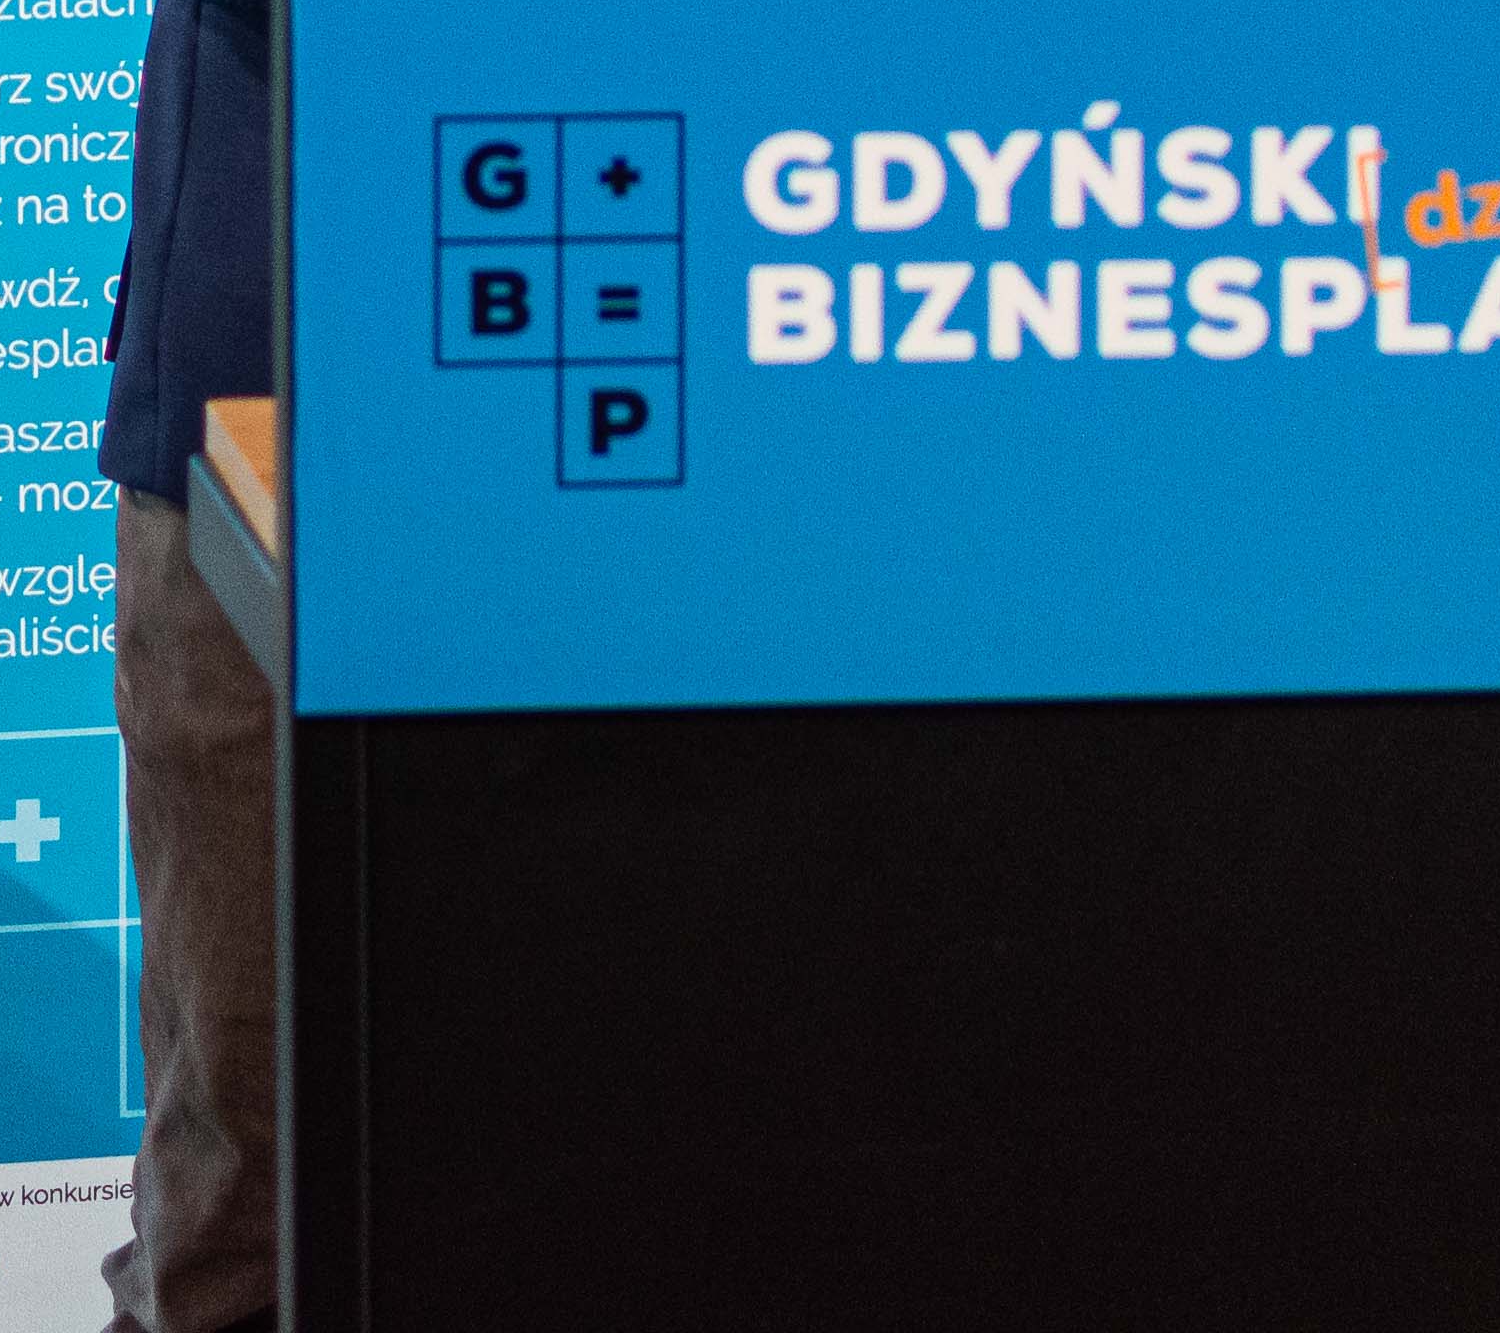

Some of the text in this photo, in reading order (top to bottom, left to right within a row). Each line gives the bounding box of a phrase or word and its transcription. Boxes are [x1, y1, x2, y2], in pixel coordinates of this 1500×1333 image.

[461, 140, 530, 212] G
[742, 99, 1381, 236] GDYŃSKI
[17, 194, 69, 225] na
[83, 185, 126, 223] to
[469, 269, 533, 336] B
[588, 389, 650, 457] P
[21, 1178, 134, 1206] konkursie
